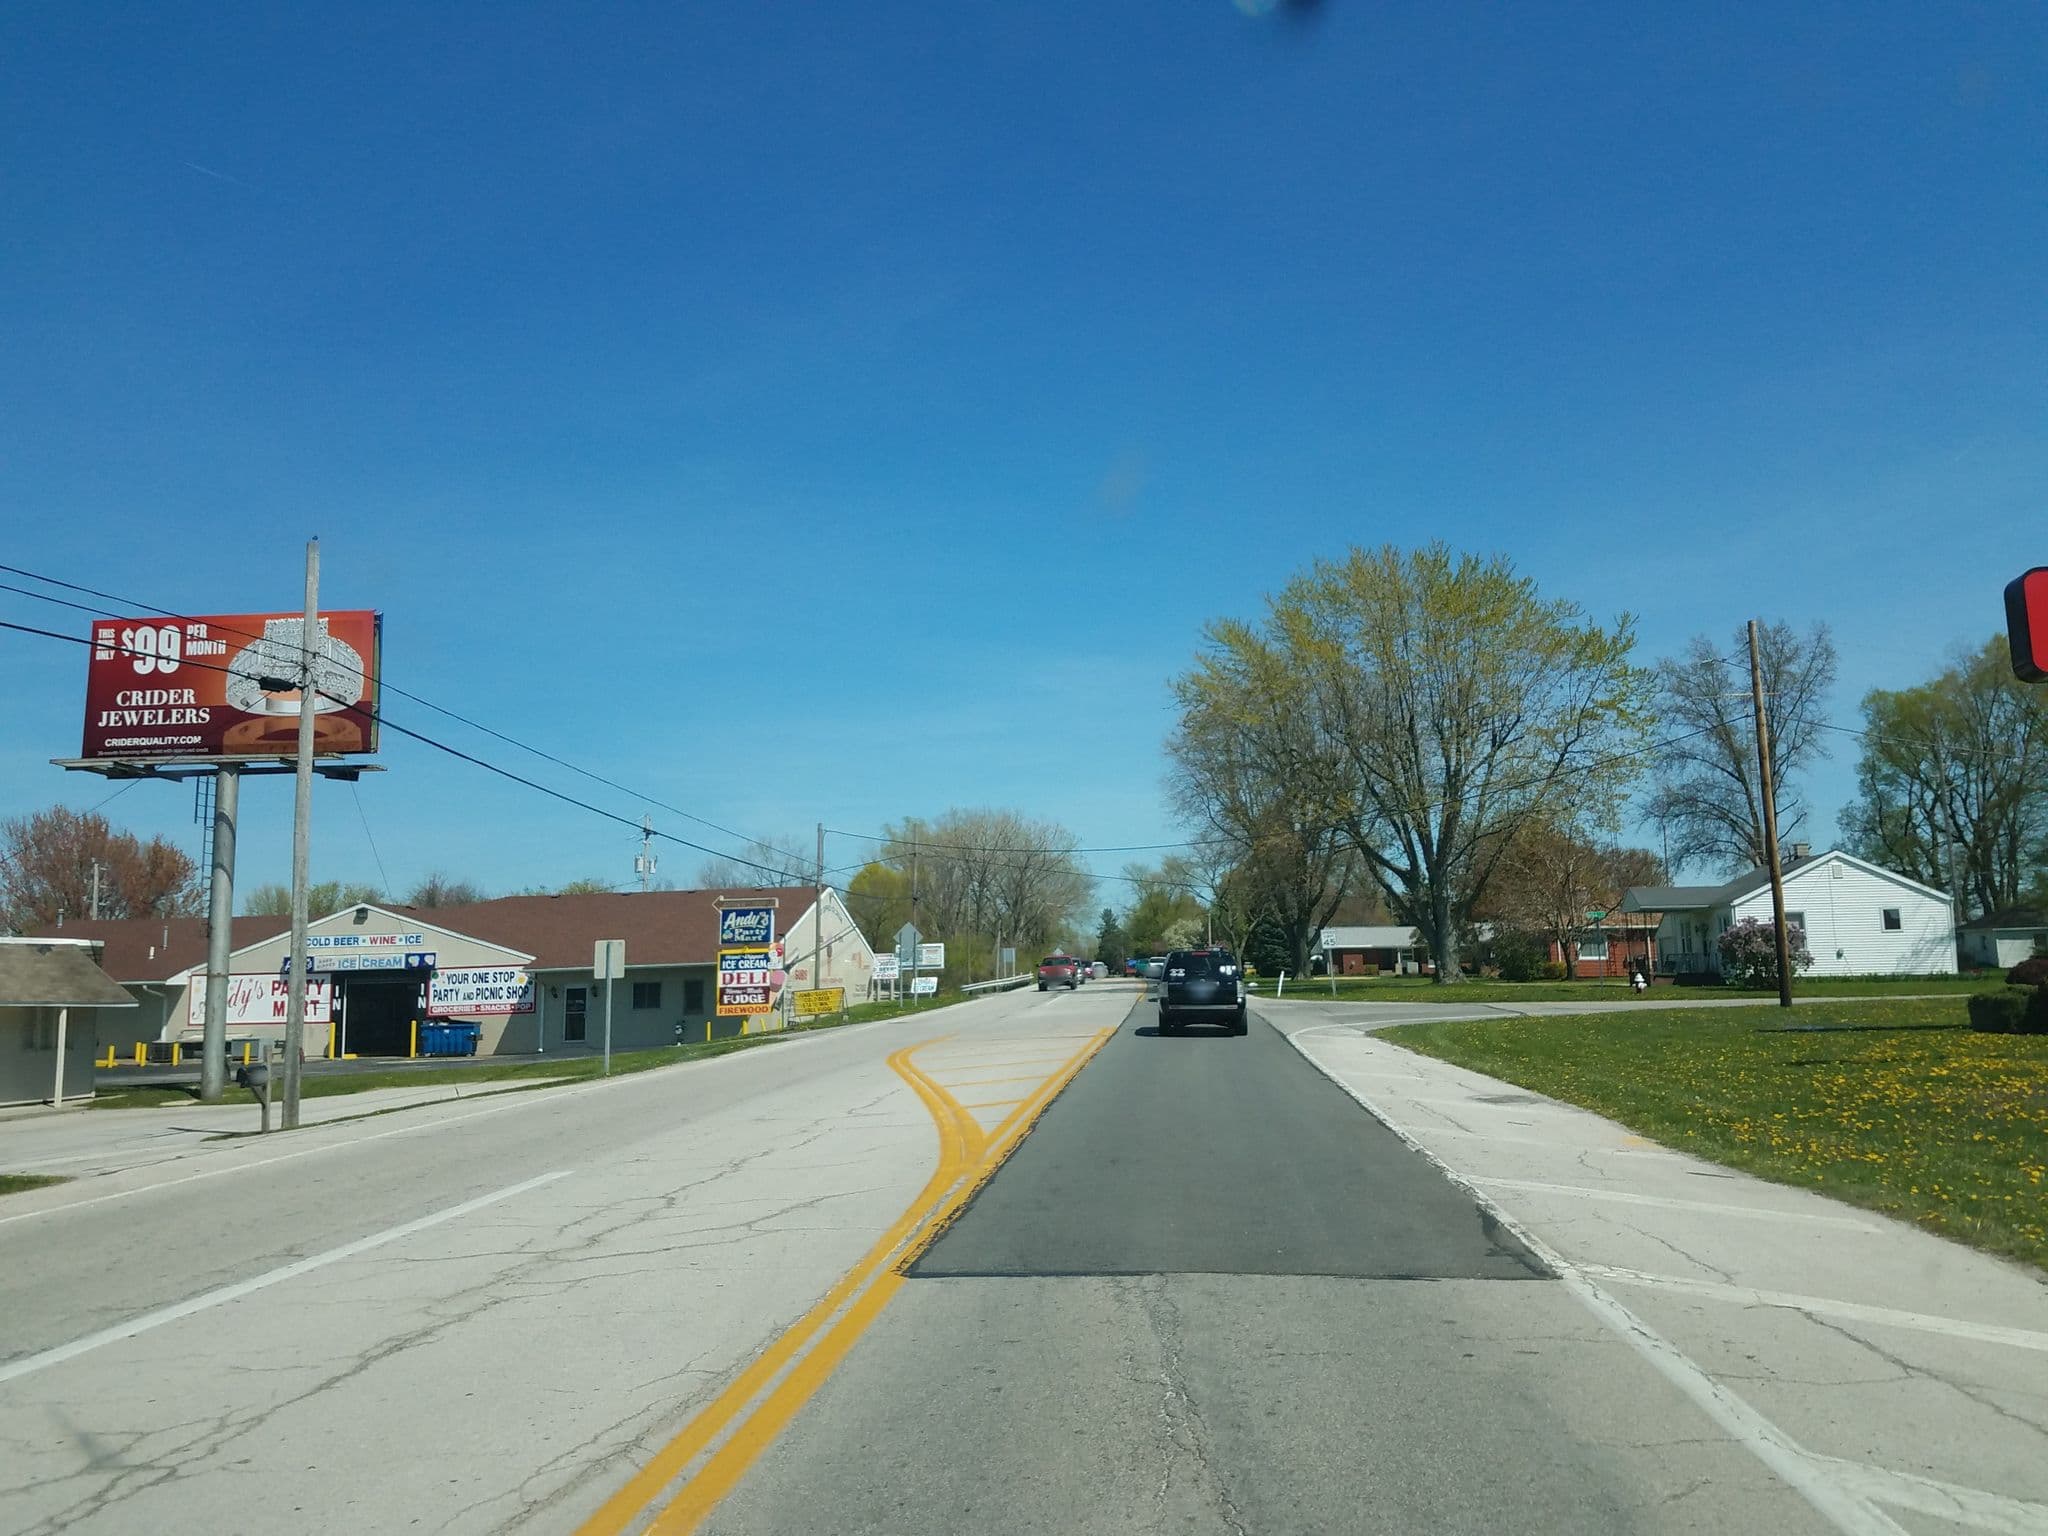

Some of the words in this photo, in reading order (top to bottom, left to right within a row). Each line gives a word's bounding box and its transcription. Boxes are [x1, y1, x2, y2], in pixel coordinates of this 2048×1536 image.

[186, 624, 208, 639] PER
[121, 625, 181, 675] $99
[186, 640, 227, 656] MONTH
[116, 688, 197, 707] CRIDER
[98, 707, 211, 727] JEWELERS
[105, 735, 202, 747] CRIDERQUALITY.COM
[723, 911, 769, 929] Andy's
[306, 937, 331, 947] COLD
[333, 936, 360, 946] BEER
[369, 935, 397, 945] WINE
[404, 935, 422, 945] ICE
[338, 959, 357, 969] ICE
[361, 957, 403, 969] CREAM
[722, 960, 737, 969] ICE
[738, 959, 768, 969] CREAM
[446, 973, 470, 985] YOUR
[472, 972, 490, 984] ONE
[492, 971, 516, 983] STOP
[722, 972, 768, 985] DELI
[271, 979, 325, 996] PATY
[432, 988, 461, 1002] PARTY
[463, 992, 475, 1001] AND
[475, 987, 504, 1000] PICNIC
[506, 985, 530, 999] SHOP
[723, 994, 767, 1004] FUDGE
[480, 1004, 511, 1012] SNACKS
[719, 1006, 769, 1014] FIREWOOD
